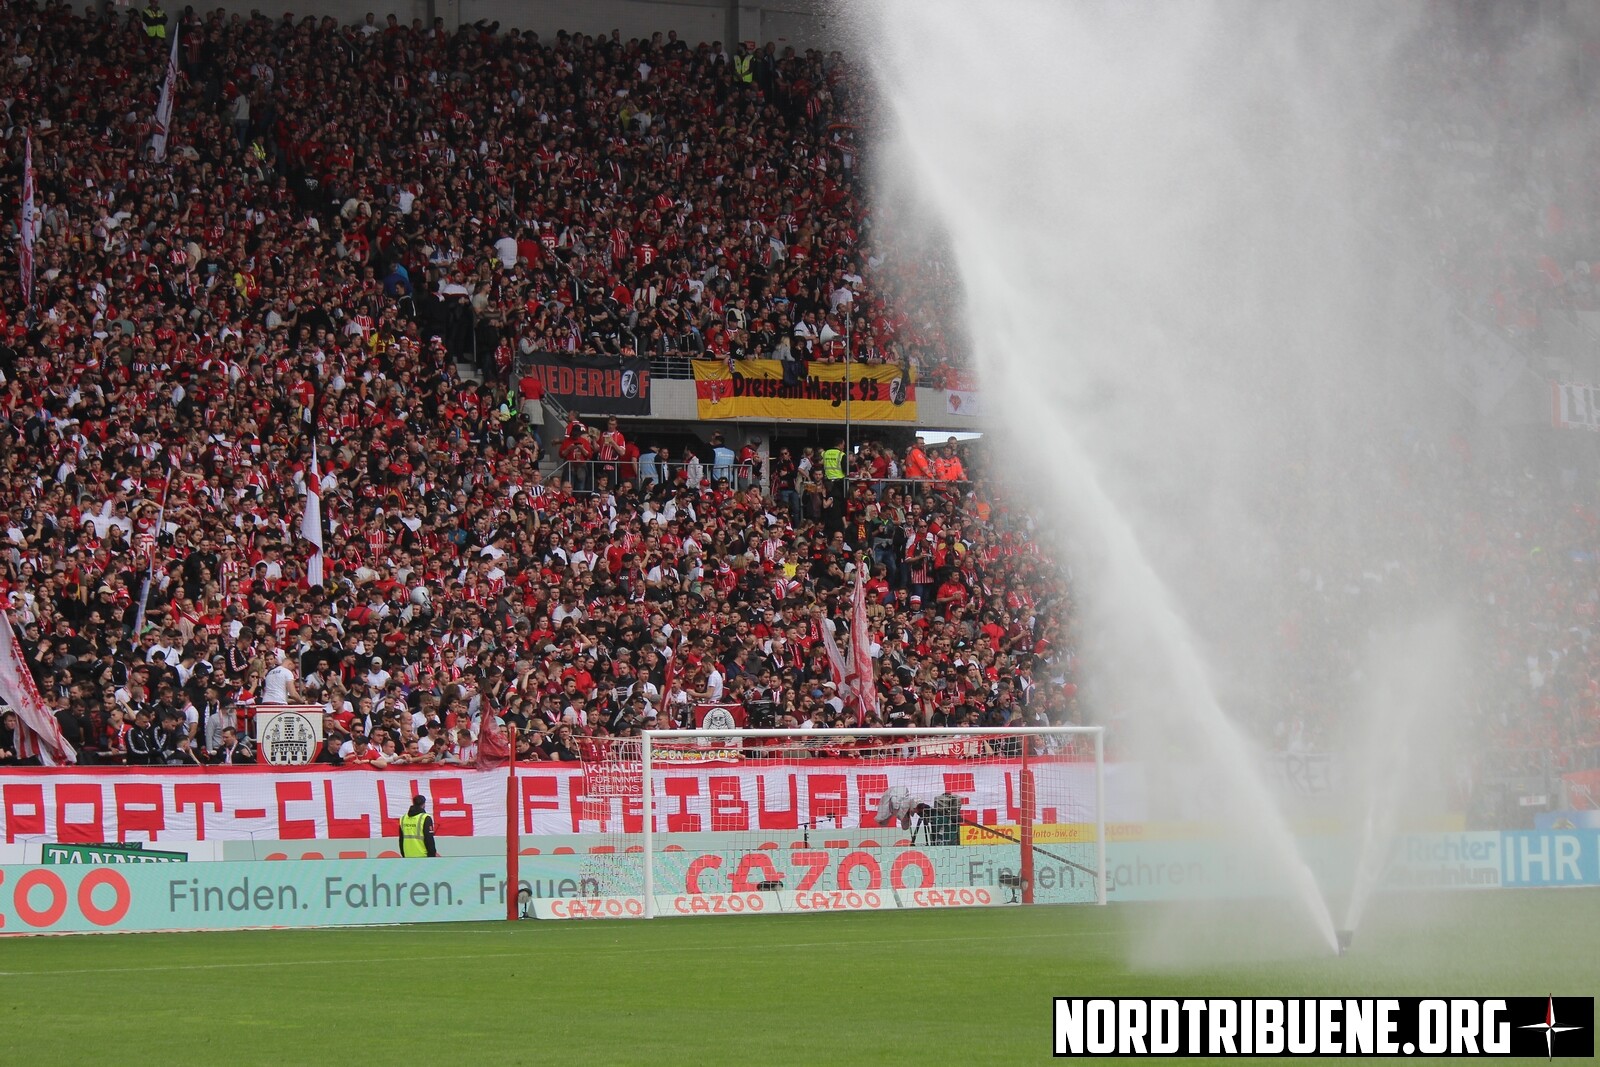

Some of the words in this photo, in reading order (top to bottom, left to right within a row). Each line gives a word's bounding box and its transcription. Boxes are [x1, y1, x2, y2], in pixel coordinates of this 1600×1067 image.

[732, 371, 803, 397] Dreisam
[859, 377, 878, 401] 95
[590, 774, 610, 784] FÜR
[599, 785, 614, 795] BEI
[616, 784, 640, 794] UNS
[980, 828, 1014, 840] LOTTO
[49, 848, 182, 864] TANN
[1505, 834, 1583, 881] IHR
[686, 850, 935, 894] CAZOO
[969, 860, 1084, 889] Finen.
[0, 868, 131, 927] OO
[169, 877, 308, 912] Finden.
[325, 874, 463, 908] Fahren.
[480, 871, 599, 905] Fruen
[795, 891, 881, 909] CAZOO
[913, 888, 991, 907] CAZOO
[551, 897, 643, 918] CAZOO
[674, 894, 764, 914] CAZOO
